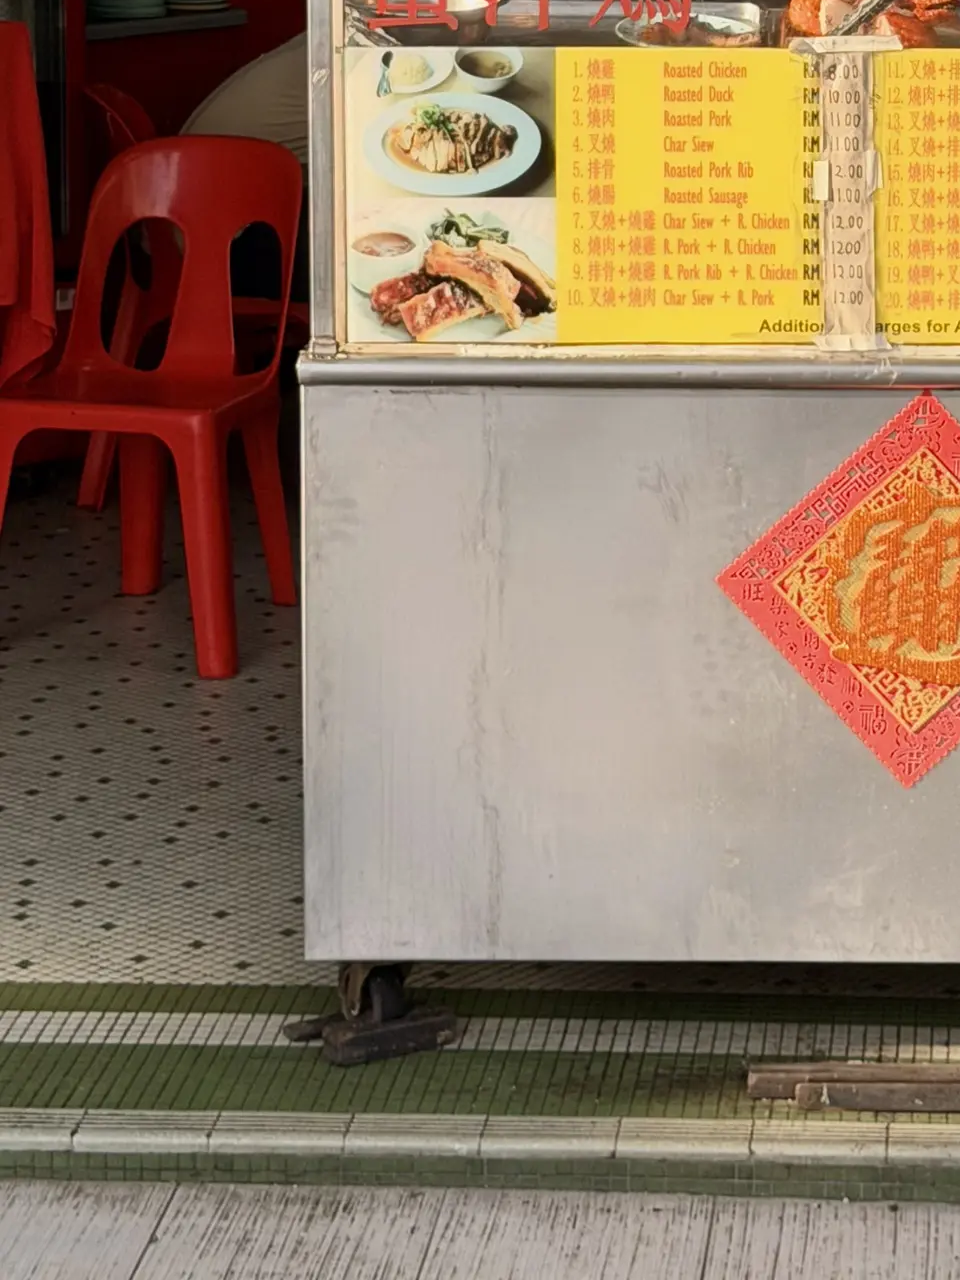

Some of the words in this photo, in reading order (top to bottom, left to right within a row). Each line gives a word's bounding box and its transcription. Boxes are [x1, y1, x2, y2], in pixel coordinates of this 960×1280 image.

[663, 61, 703, 78] Roasted
[709, 61, 747, 78] Chicken
[664, 85, 703, 102] Roasted
[709, 86, 734, 102] Duck
[803, 87, 820, 104] RM
[664, 110, 703, 127] Roasted
[709, 109, 732, 127] Pork
[803, 111, 820, 127] RM
[664, 136, 687, 152] Char
[692, 136, 714, 152] Siew
[803, 136, 820, 152] RM
[664, 161, 703, 178] Roasted
[709, 161, 732, 178] Pork
[738, 161, 754, 178] Rib
[664, 187, 703, 204] Roasted
[709, 187, 748, 207] Sausage
[663, 213, 686, 229] Char
[692, 213, 714, 229] Siew
[752, 212, 790, 230] Chicken
[803, 213, 820, 230] RM
[678, 238, 700, 255] Pork
[737, 238, 776, 255] Chicken
[803, 238, 820, 255] RM
[677, 264, 700, 280] Pork
[706, 264, 722, 280] Rib
[760, 264, 798, 280] Chicken
[803, 264, 820, 280] RM
[664, 289, 686, 306] Char
[692, 289, 714, 306] Siew
[752, 289, 775, 306] Pork
[803, 289, 820, 306] RM
[927, 319, 950, 334] for
